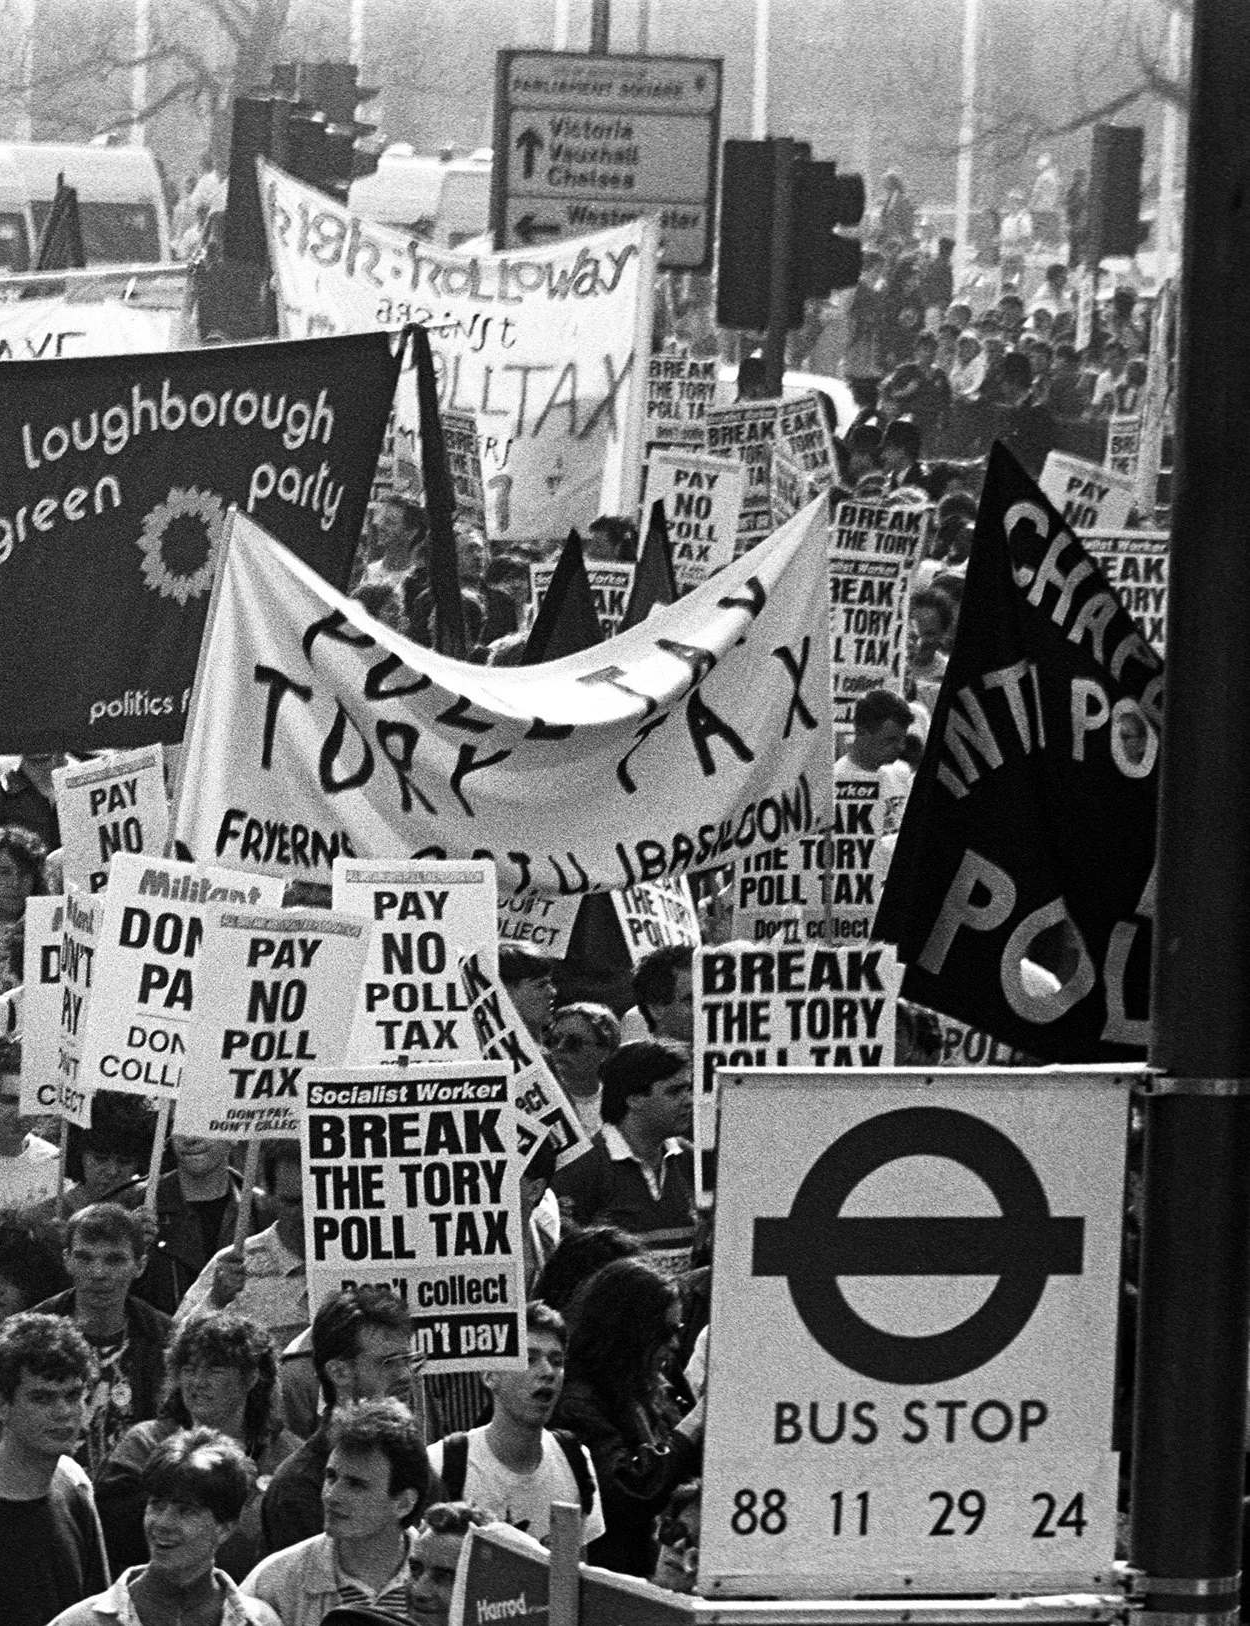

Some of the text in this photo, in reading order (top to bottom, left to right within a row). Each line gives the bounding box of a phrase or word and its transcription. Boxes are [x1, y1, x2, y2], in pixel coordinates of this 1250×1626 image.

[551, 118, 633, 139] Victoria
[551, 144, 638, 165] Vauxhall
[549, 167, 635, 190] Chelsea
[649, 360, 715, 379] BREAK
[648, 381, 716, 400] THE TORY
[648, 401, 681, 420] POLL
[707, 420, 776, 448] BREAK
[674, 469, 719, 489] PAY
[1066, 475, 1110, 502] PAY
[249, 461, 345, 532] party
[674, 493, 713, 521] NO
[839, 505, 924, 534] BREAK
[1064, 500, 1099, 529] NO
[836, 529, 920, 556] THE TORY
[844, 608, 893, 637] TORY
[854, 638, 890, 666] TAX
[89, 686, 174, 722] politics
[254, 637, 819, 818] TORY TAX
[88, 778, 139, 817] PAY
[98, 816, 144, 863] NO
[800, 838, 876, 870] TORY
[137, 868, 263, 908] Militant
[624, 890, 658, 916] THE
[740, 873, 875, 910] POLL TAX
[373, 890, 450, 921] PAY
[247, 937, 324, 970] PAY
[382, 930, 448, 976] NO
[137, 963, 194, 1012] PA
[702, 950, 886, 995] BREAK
[247, 978, 308, 1025] NO
[365, 981, 469, 1013] POLL
[375, 1019, 459, 1051] TAX
[702, 998, 886, 1043] THE TORY
[221, 1029, 317, 1061] POLL
[99, 1054, 183, 1088] COLL
[228, 1067, 304, 1101] TAX
[309, 1082, 503, 1106] Socialist Worker
[210, 1119, 250, 1132] DON'T
[307, 1109, 507, 1160] BREAK
[309, 1159, 508, 1211] THE TORY
[313, 1210, 512, 1262] POLL TAX
[417, 1272, 509, 1306] collect
[460, 1322, 510, 1358] pay
[773, 1399, 1050, 1445] BUS STOP
[730, 1488, 1088, 1539] 88 11 29 24
